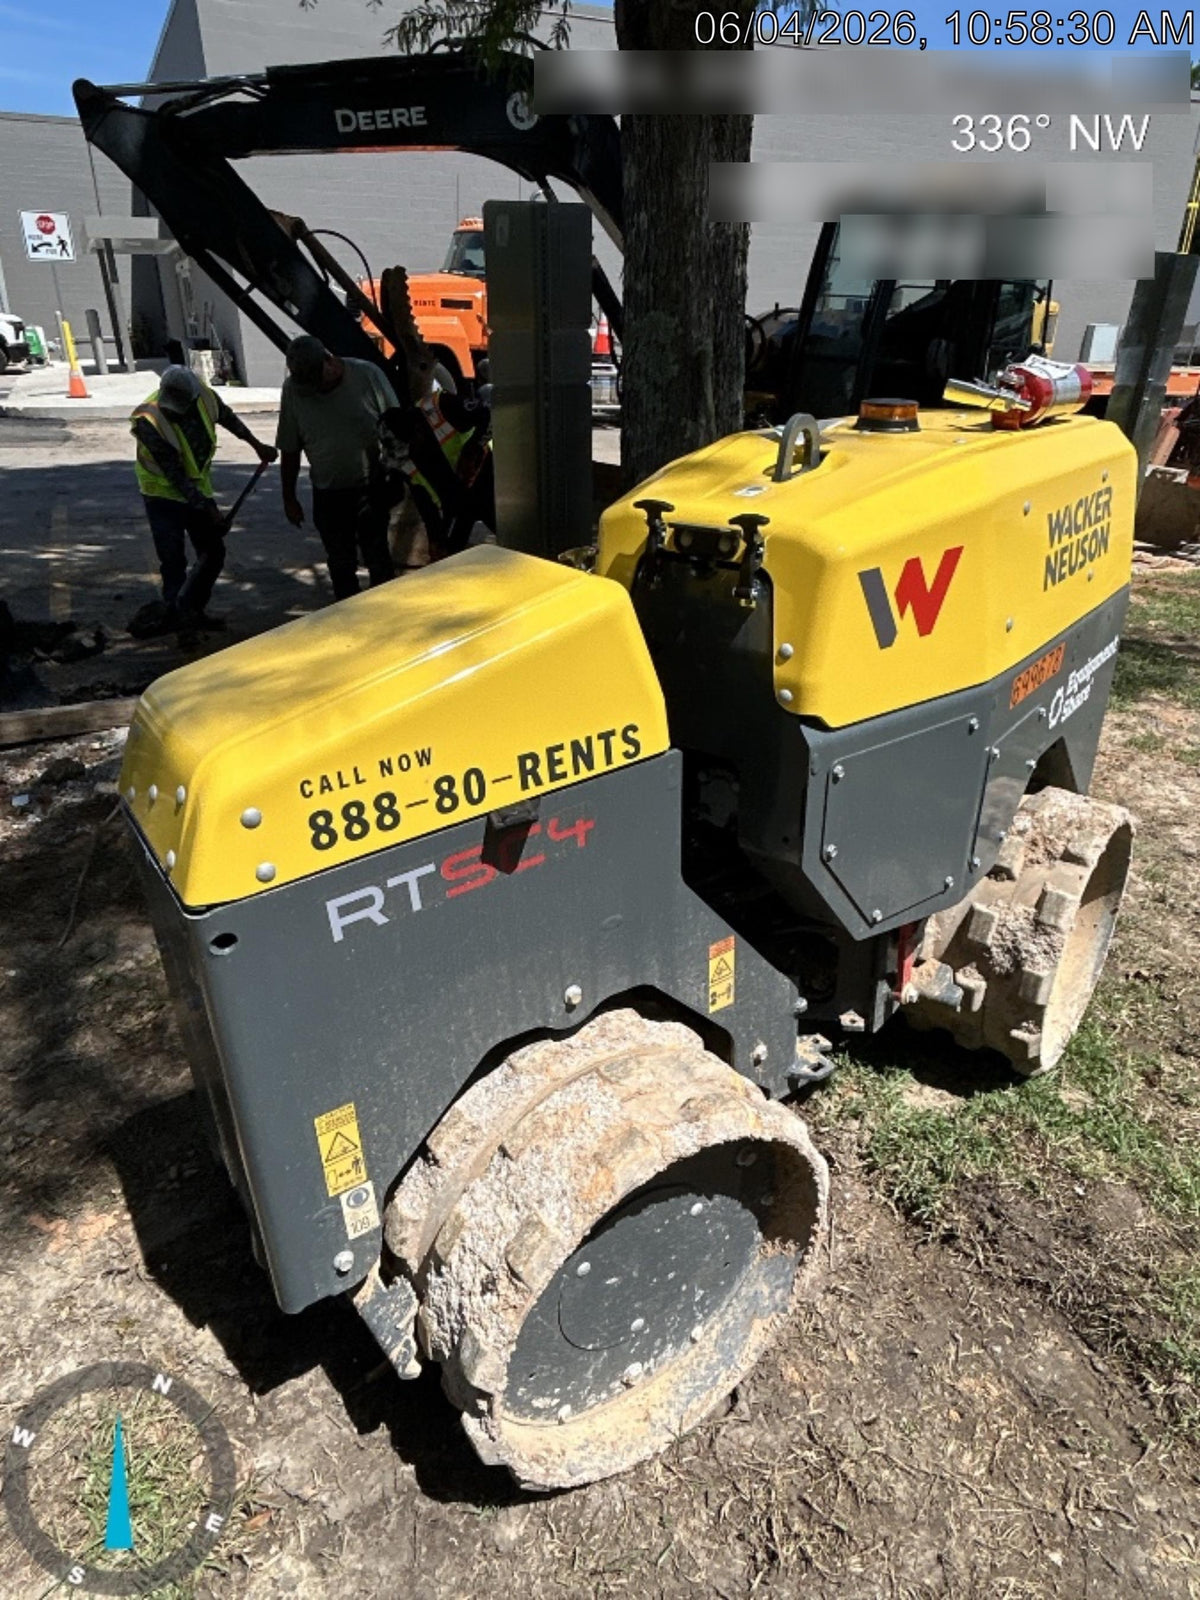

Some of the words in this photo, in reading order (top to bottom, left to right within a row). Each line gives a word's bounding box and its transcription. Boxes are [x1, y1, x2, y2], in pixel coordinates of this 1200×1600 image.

[335, 105, 428, 133] DEERE
[1047, 486, 1113, 548] WACKER
[1043, 522, 1110, 592] NEUSON
[300, 766, 366, 799] CALL
[379, 747, 433, 778] NOW
[308, 723, 642, 852] 888-80-RENTS
